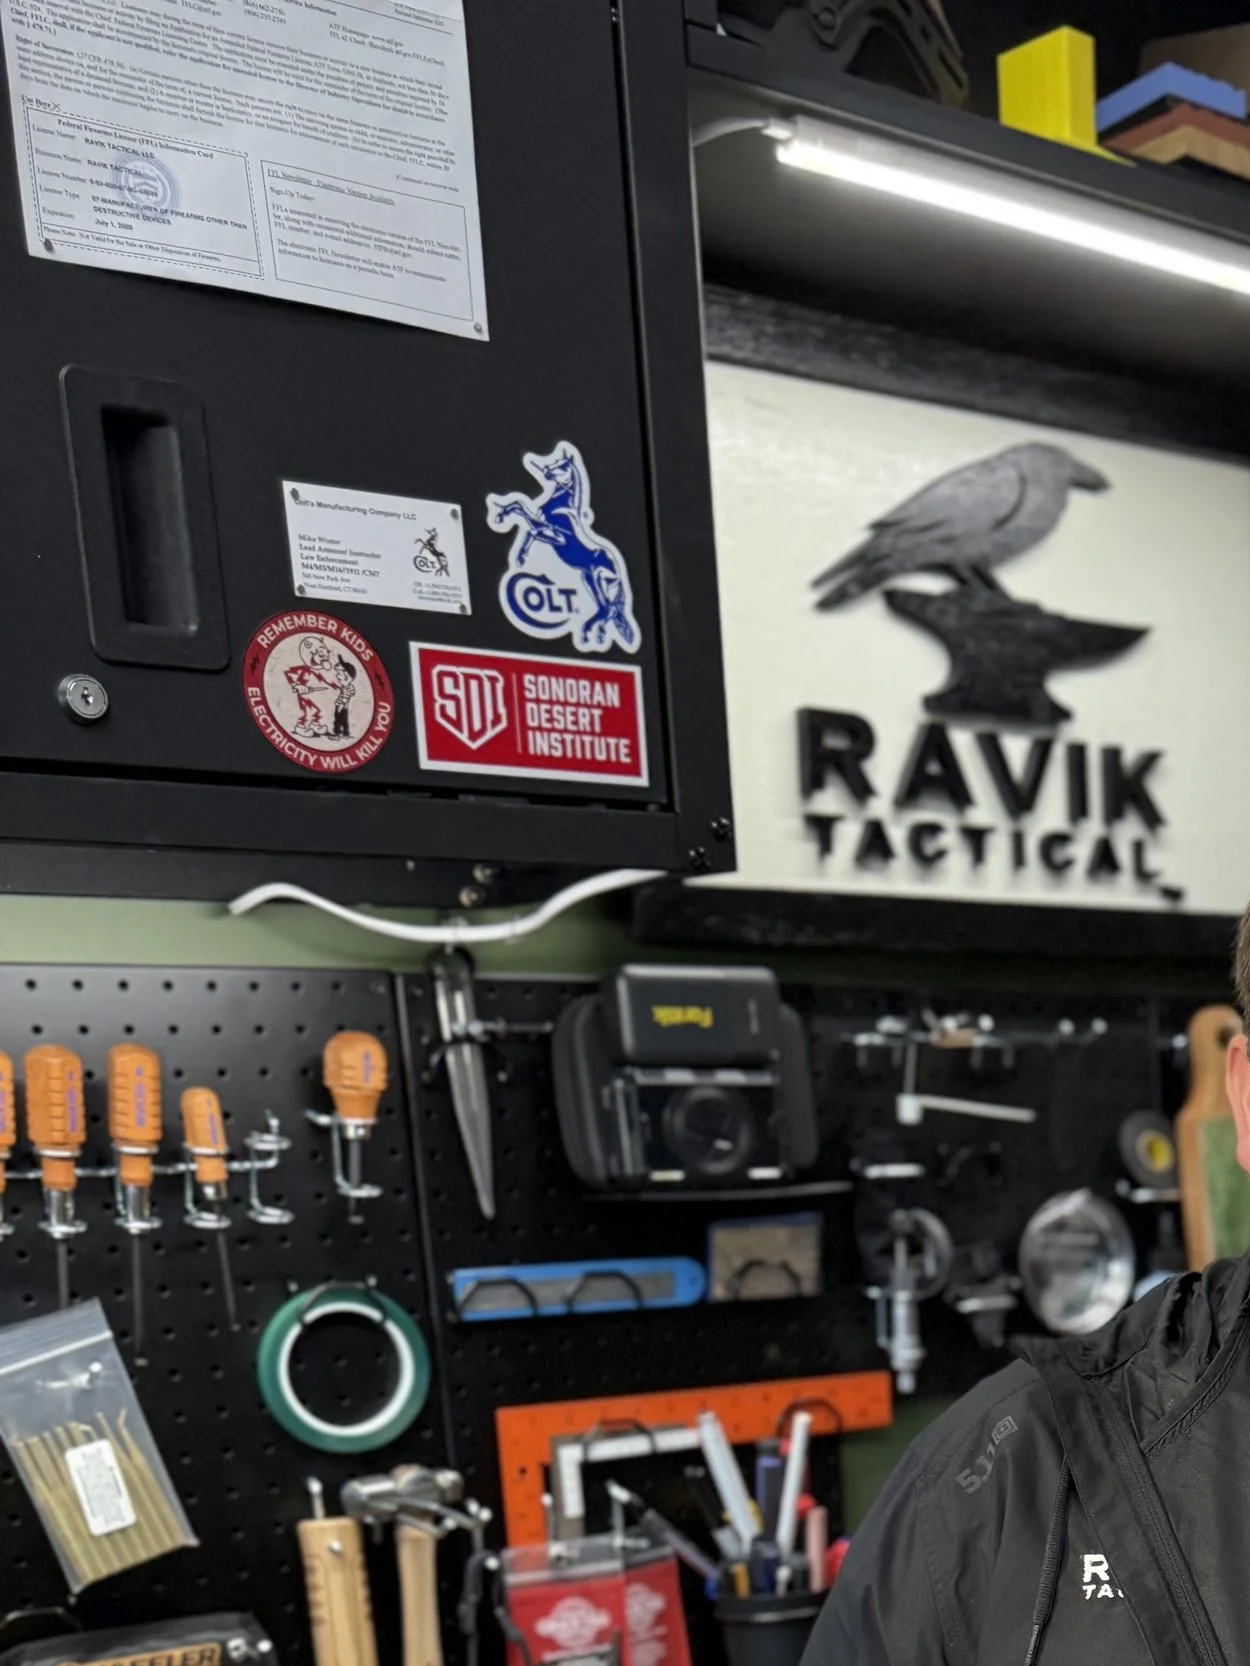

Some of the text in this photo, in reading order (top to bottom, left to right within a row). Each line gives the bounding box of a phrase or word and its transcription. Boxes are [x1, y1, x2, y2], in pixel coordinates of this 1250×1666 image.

[58, 119, 83, 132] Federal
[84, 124, 113, 137] Firearms
[114, 129, 137, 142] License
[158, 140, 196, 156] Information
[197, 149, 214, 160] Card
[85, 137, 105, 149] RAVIK
[107, 141, 141, 156] TACTICAL
[87, 159, 143, 176] RAVIK TACTICAL
[93, 206, 172, 226] DESTRUCTIVE DEVICES
[206, 216, 228, 226] OTHER
[229, 219, 247, 230] THAN
[316, 501, 368, 515] Manufacturing
[368, 507, 401, 520] Company
[402, 512, 417, 521] LLC
[299, 543, 316, 552] Lead
[412, 555, 439, 574] COLT
[506, 571, 577, 630] COLT
[257, 614, 374, 661] REMEMBER KIDS
[523, 673, 621, 708] SONORAN
[431, 664, 507, 751] SDI
[525, 702, 604, 734] DESERT
[247, 686, 392, 770] ELECTRICITY WILL KILL YOU
[527, 731, 632, 764] INSTITUTE
[795, 707, 1167, 835] RAVIK
[801, 813, 1162, 882] TACTICAL
